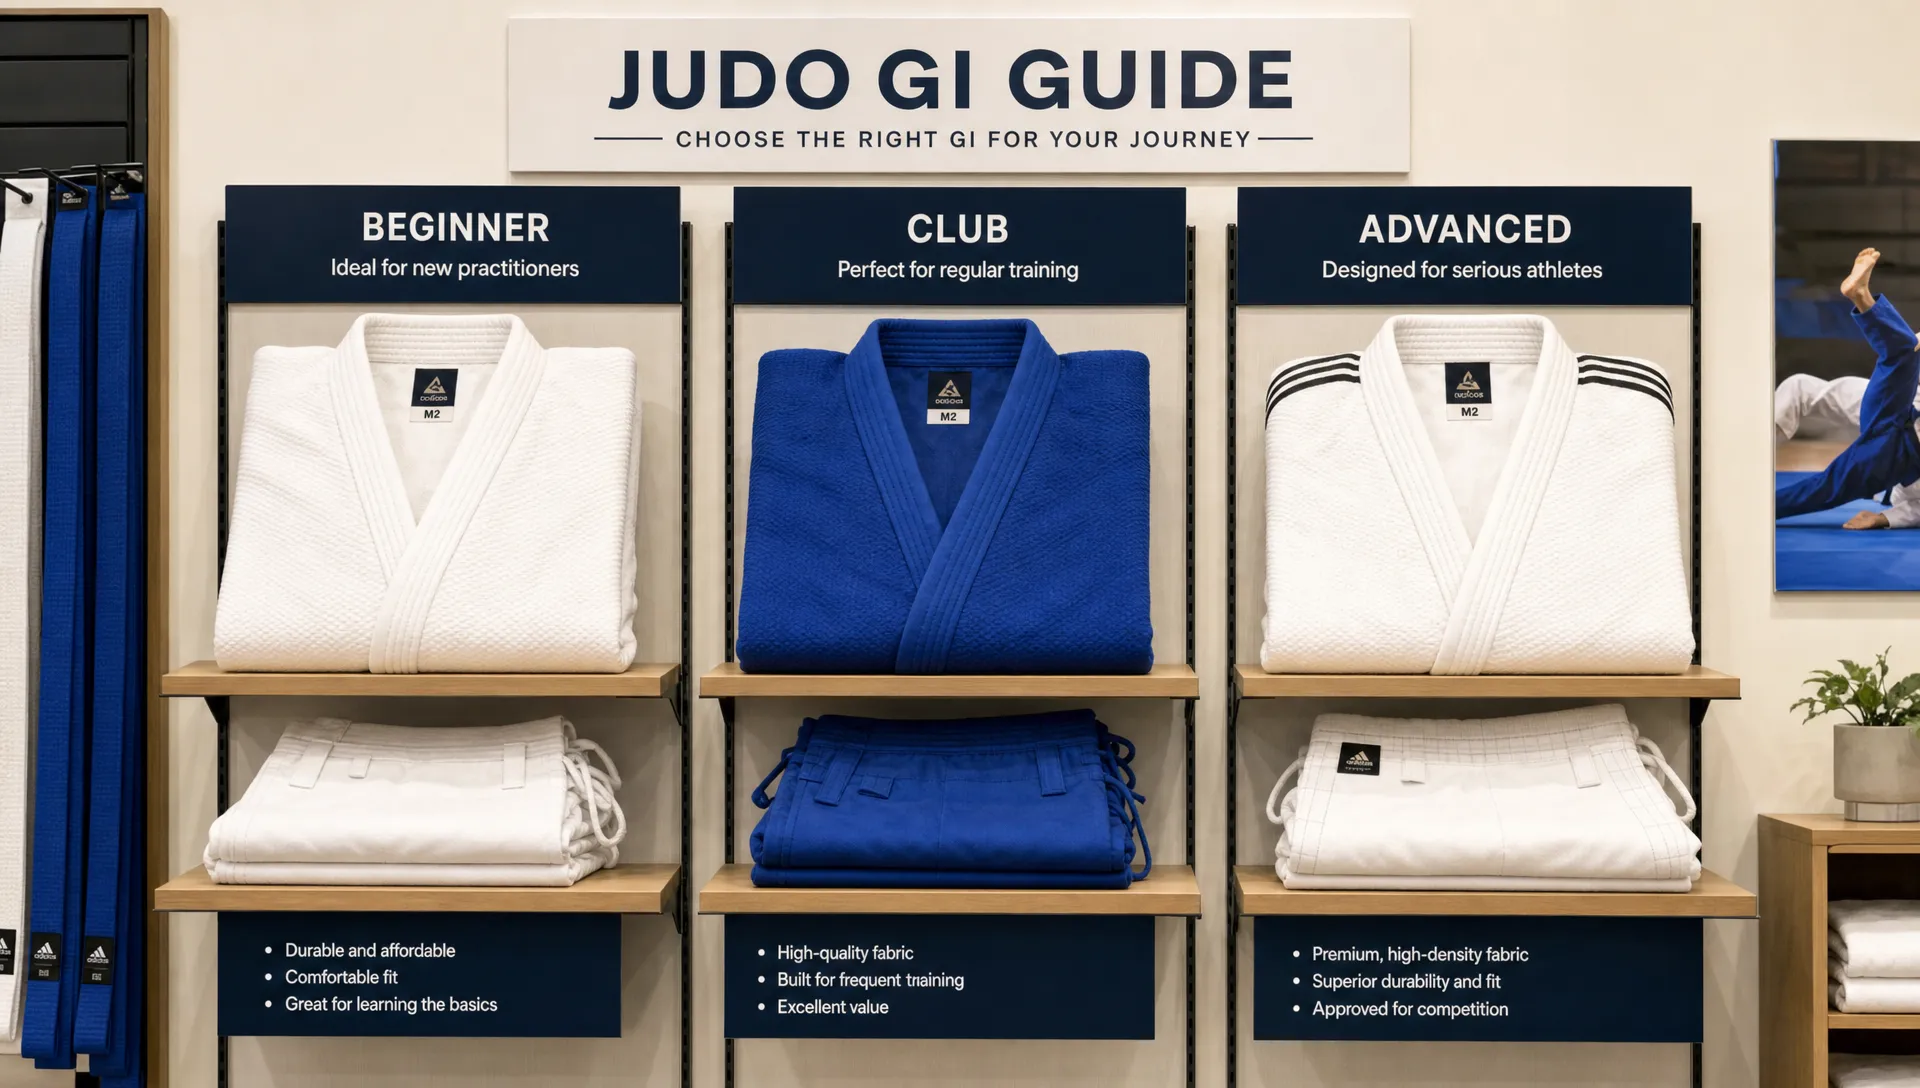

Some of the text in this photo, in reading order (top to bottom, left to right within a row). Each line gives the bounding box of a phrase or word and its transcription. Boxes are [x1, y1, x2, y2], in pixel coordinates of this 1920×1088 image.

[608, 48, 1292, 110] JUDO GI GUIDE
[676, 130, 1249, 147] CHOOSE THE RIGHT GI FOR YOUR JOURNEY
[363, 211, 549, 241] BEGINNER
[907, 213, 1008, 243] CLUB
[1358, 213, 1571, 243] ADVANCED
[331, 257, 579, 280] Ideal for new practitioners
[838, 259, 1078, 282] Perfect for regular training
[1322, 260, 1602, 282] Designed for serious athletes
[423, 409, 441, 419] M2
[940, 412, 957, 421] M2
[1461, 407, 1479, 417] M2
[285, 942, 455, 957] Durable and affordable
[777, 944, 913, 963] High-quality fabric
[1312, 945, 1528, 965] Premium, high-density fabric
[285, 968, 398, 984] Comfortable fit
[777, 971, 811, 986] Built
[814, 971, 835, 986] for
[838, 971, 901, 990] frequent
[1312, 972, 1501, 992] Superior durability and fit
[285, 995, 497, 1014] Great for learning the basics
[777, 998, 888, 1014] Excellent value
[1312, 1000, 1508, 1019] Approved for competition
